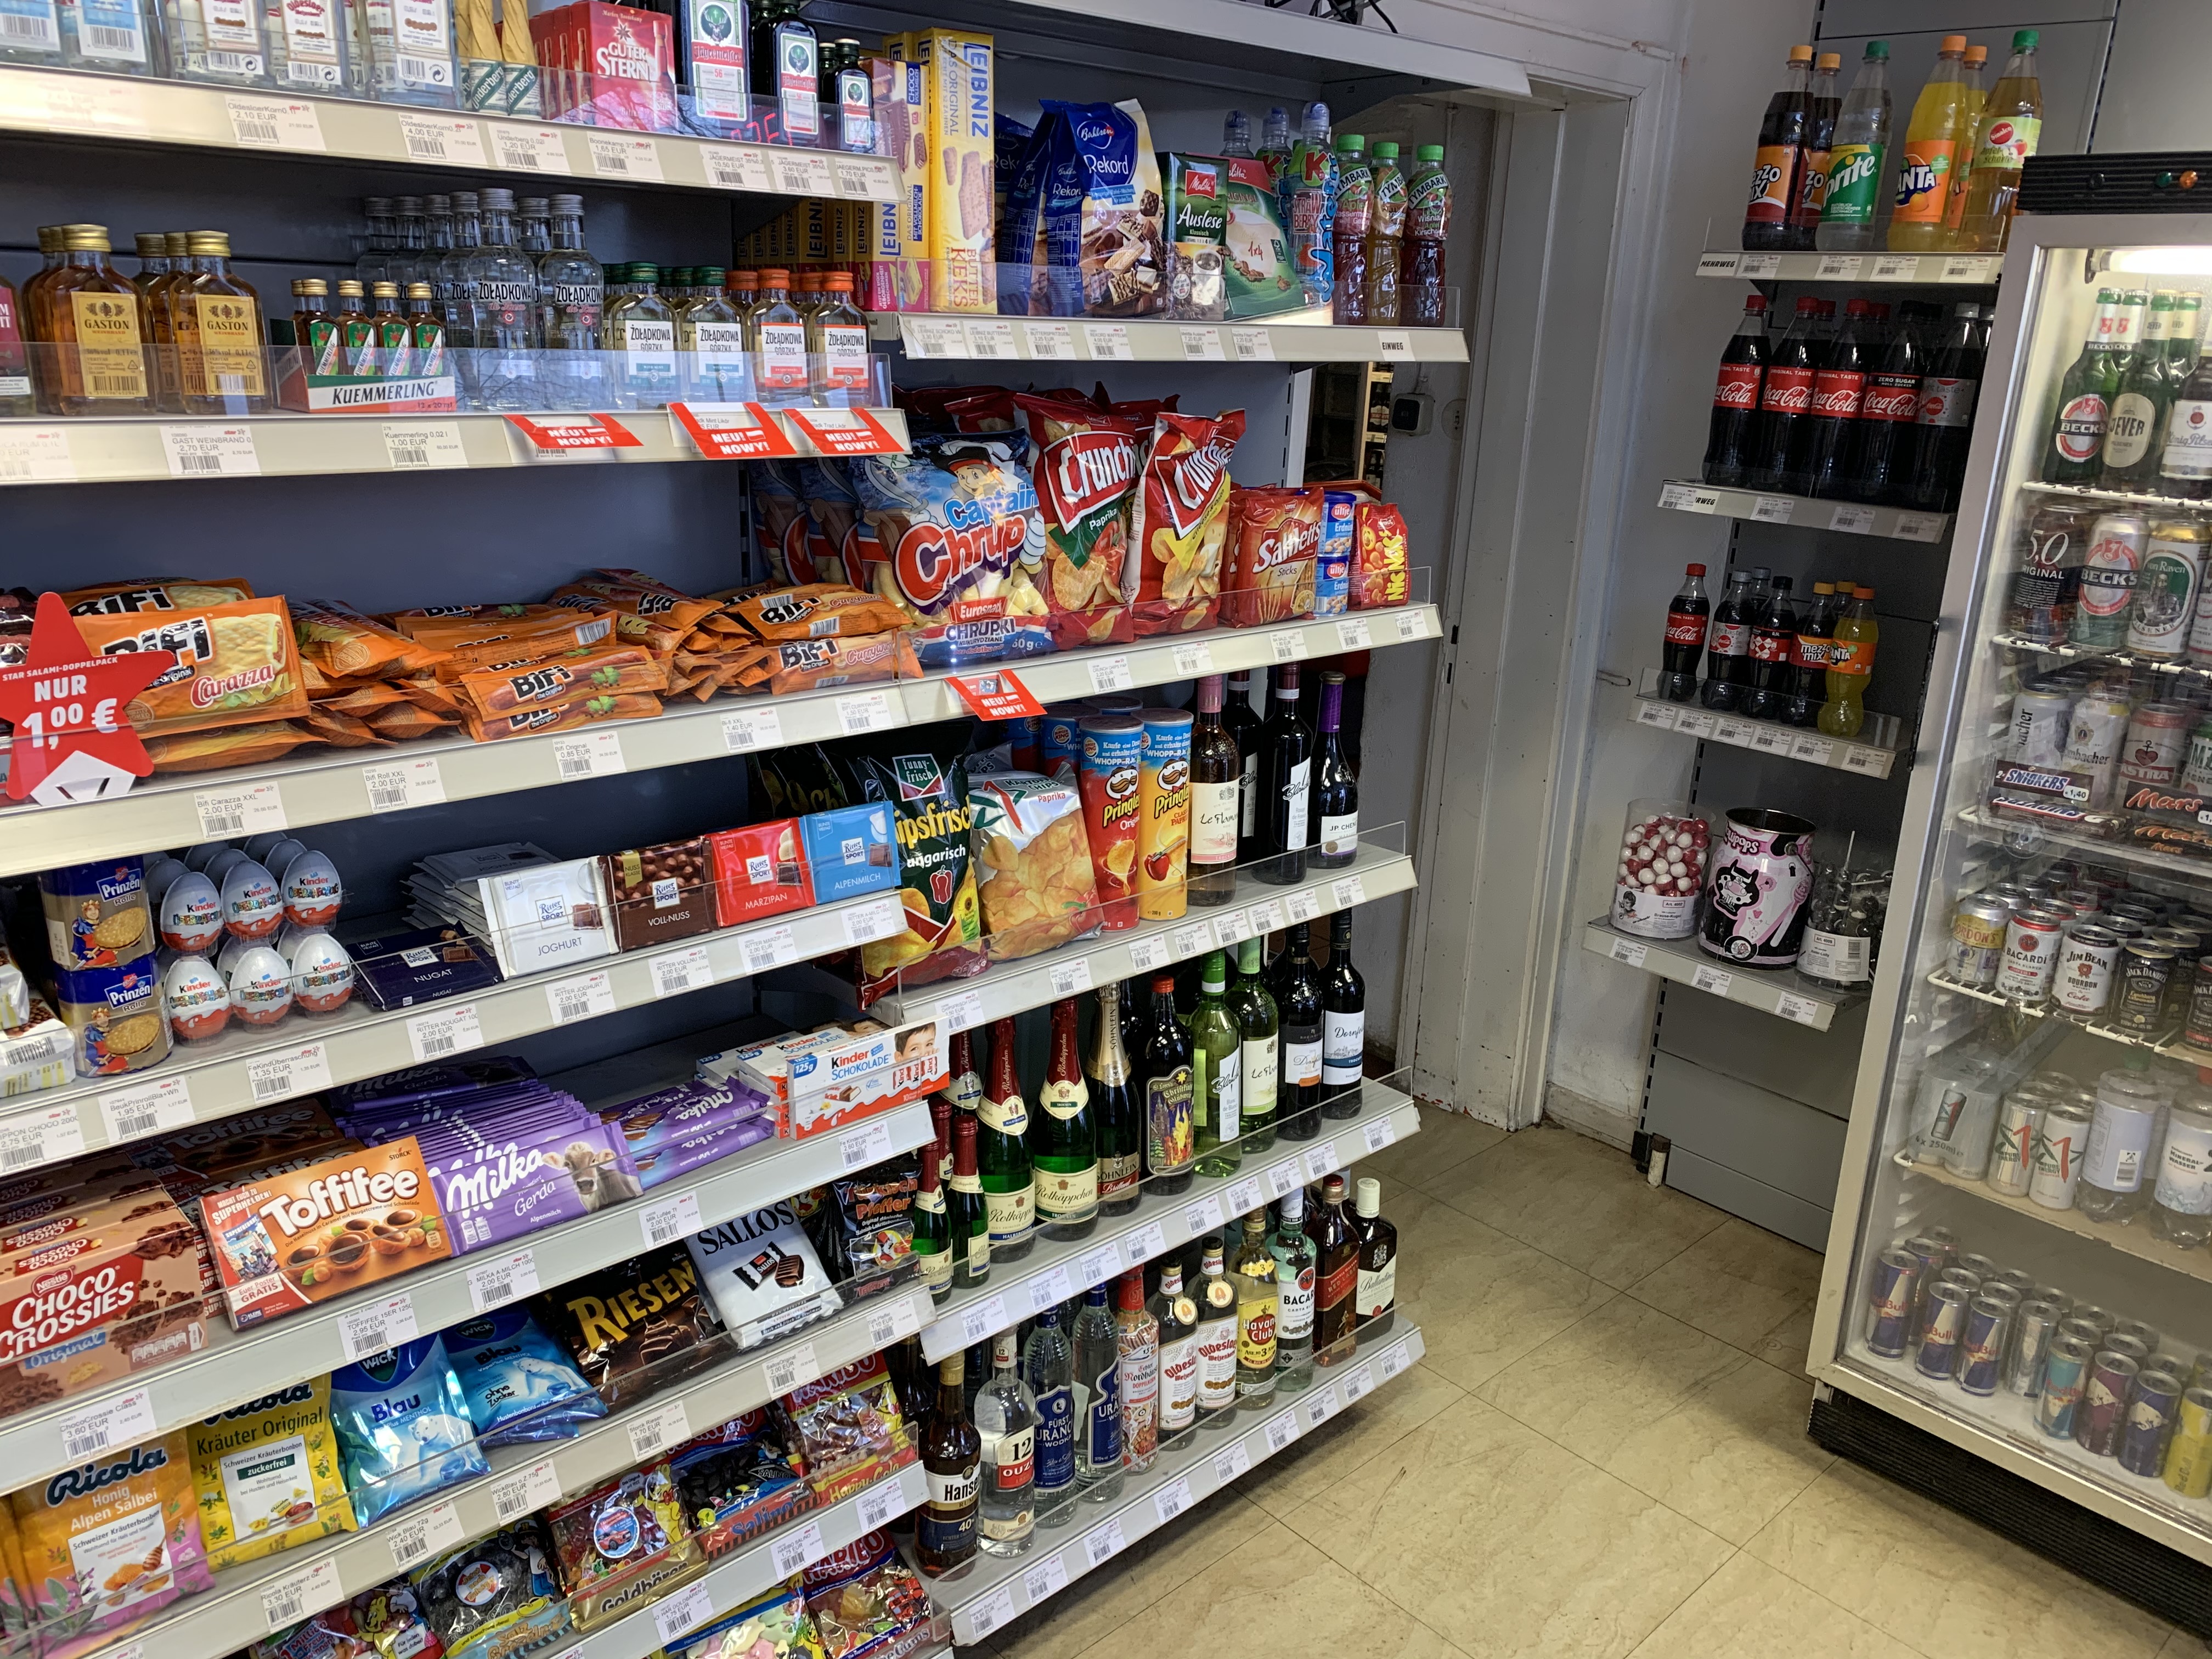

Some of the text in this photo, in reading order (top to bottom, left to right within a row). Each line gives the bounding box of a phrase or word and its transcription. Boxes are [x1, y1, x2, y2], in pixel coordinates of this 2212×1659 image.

[608, 43, 646, 62] GUTER
[596, 48, 651, 80] STERN
[964, 42, 991, 138] LEIBNIZ
[1081, 127, 1113, 141] Bahlsen
[1084, 155, 1128, 175] Rekord
[1190, 176, 1212, 194] Melitta
[1180, 204, 1222, 229] Auslese
[1701, 259, 1736, 269] MEHRWEG
[951, 247, 967, 307] KEKS
[966, 249, 978, 307] BUTTER
[478, 279, 532, 302] ŻOŁĄDKOWA
[84, 320, 129, 331] GASTON
[208, 321, 249, 332] GASTON
[631, 324, 671, 341] ŻOŁĄDKOWA
[765, 329, 803, 345] ŻOŁĄDKOWA
[333, 382, 435, 405] KUEMMERLING
[712, 432, 745, 443] NEU!
[2111, 418, 2145, 438] JEVER
[721, 441, 770, 455] NOWY!
[944, 482, 1039, 531] Captain
[1333, 505, 1350, 518] ültje
[1090, 510, 1117, 531] Paprika
[898, 516, 1025, 606] Chrup
[2159, 561, 2186, 574] Raven
[1278, 567, 1296, 575] Sticks
[946, 618, 1015, 641] CHRUPKI
[959, 636, 1003, 647] KUKURYDZIANE
[1801, 644, 1831, 654] mezzo
[1803, 651, 1824, 662] mix
[3, 657, 118, 681] STAR SALAMI-DOPPELPACK
[34, 675, 87, 702] NUR
[190, 665, 275, 709] Carazza
[537, 682, 562, 700] The Original
[21, 698, 118, 750] 1,00 €
[566, 743, 587, 751] Original
[903, 756, 930, 771] funny-
[906, 769, 934, 783] frisch
[2007, 769, 2068, 791] SNICKERS
[211, 796, 241, 807] Carazza
[2070, 789, 2086, 799] 1,40
[2126, 788, 2203, 814] Mars
[205, 803, 243, 814] 2,00 EUR
[844, 841, 864, 852] Ritter
[906, 844, 966, 868] ungarisch
[101, 877, 142, 900] Prinzen
[834, 872, 881, 891] ALPENMILCH
[115, 894, 136, 906] Rolle
[539, 900, 561, 915] Ritter
[744, 893, 788, 910] MARZIPAN
[541, 911, 565, 922] SPORT
[647, 910, 690, 927] VOLL-NUSS
[538, 936, 583, 956] JOGHURT
[2067, 951, 2084, 962] JIM
[413, 968, 453, 983] NUGAT
[2126, 967, 2143, 978] JACK
[2068, 977, 2098, 988] BOURBON
[254, 1064, 291, 1078] 1,35 EUR
[795, 1060, 816, 1075] 125g
[831, 1053, 890, 1080] SCHOKOLADE
[117, 1102, 155, 1116] 1,95 EUR
[389, 1150, 411, 1162] STORCK
[2169, 1156, 2196, 1170] WASSER
[447, 1139, 544, 1218] Milka
[259, 1168, 420, 1236] Toffifee
[515, 1180, 555, 1218] Gerda
[1036, 1183, 1093, 1207] Rotkäppchen
[213, 1189, 272, 1226] SUPERHELDEN!
[531, 1209, 561, 1223] Alpenmilch
[856, 1197, 911, 1220] Pfeffer
[697, 1200, 795, 1256] SALLOS
[477, 1264, 521, 1282] MILKA A-MILCH
[481, 1273, 511, 1288] 2,00 EUR
[35, 1275, 69, 1294] Nestlé
[241, 1282, 277, 1304] GRATIS
[12, 1267, 115, 1332] CHOCO
[566, 1260, 698, 1351] RIESEN
[1283, 1291, 1314, 1306] BACAR
[1252, 1329, 1273, 1341] Club
[29, 1331, 105, 1368] Original
[361, 1349, 398, 1369] WICK
[60, 1400, 137, 1432] ChocoCrossie Class
[371, 1394, 421, 1424] Blau
[66, 1417, 109, 1436] 3,60 EUR
[1048, 1415, 1069, 1429] FÜRST
[196, 1407, 324, 1457] Kräuter Original
[1045, 1436, 1072, 1447] WODKA
[224, 1441, 303, 1470] Schweizer Kräuterbonbon
[1012, 1440, 1031, 1461] 12
[47, 1446, 167, 1506] Ricola
[247, 1459, 287, 1476] zuckerfrei
[93, 1487, 130, 1508] Honig
[945, 1479, 979, 1502] Hanse
[71, 1488, 157, 1533] Alpen Salbei
